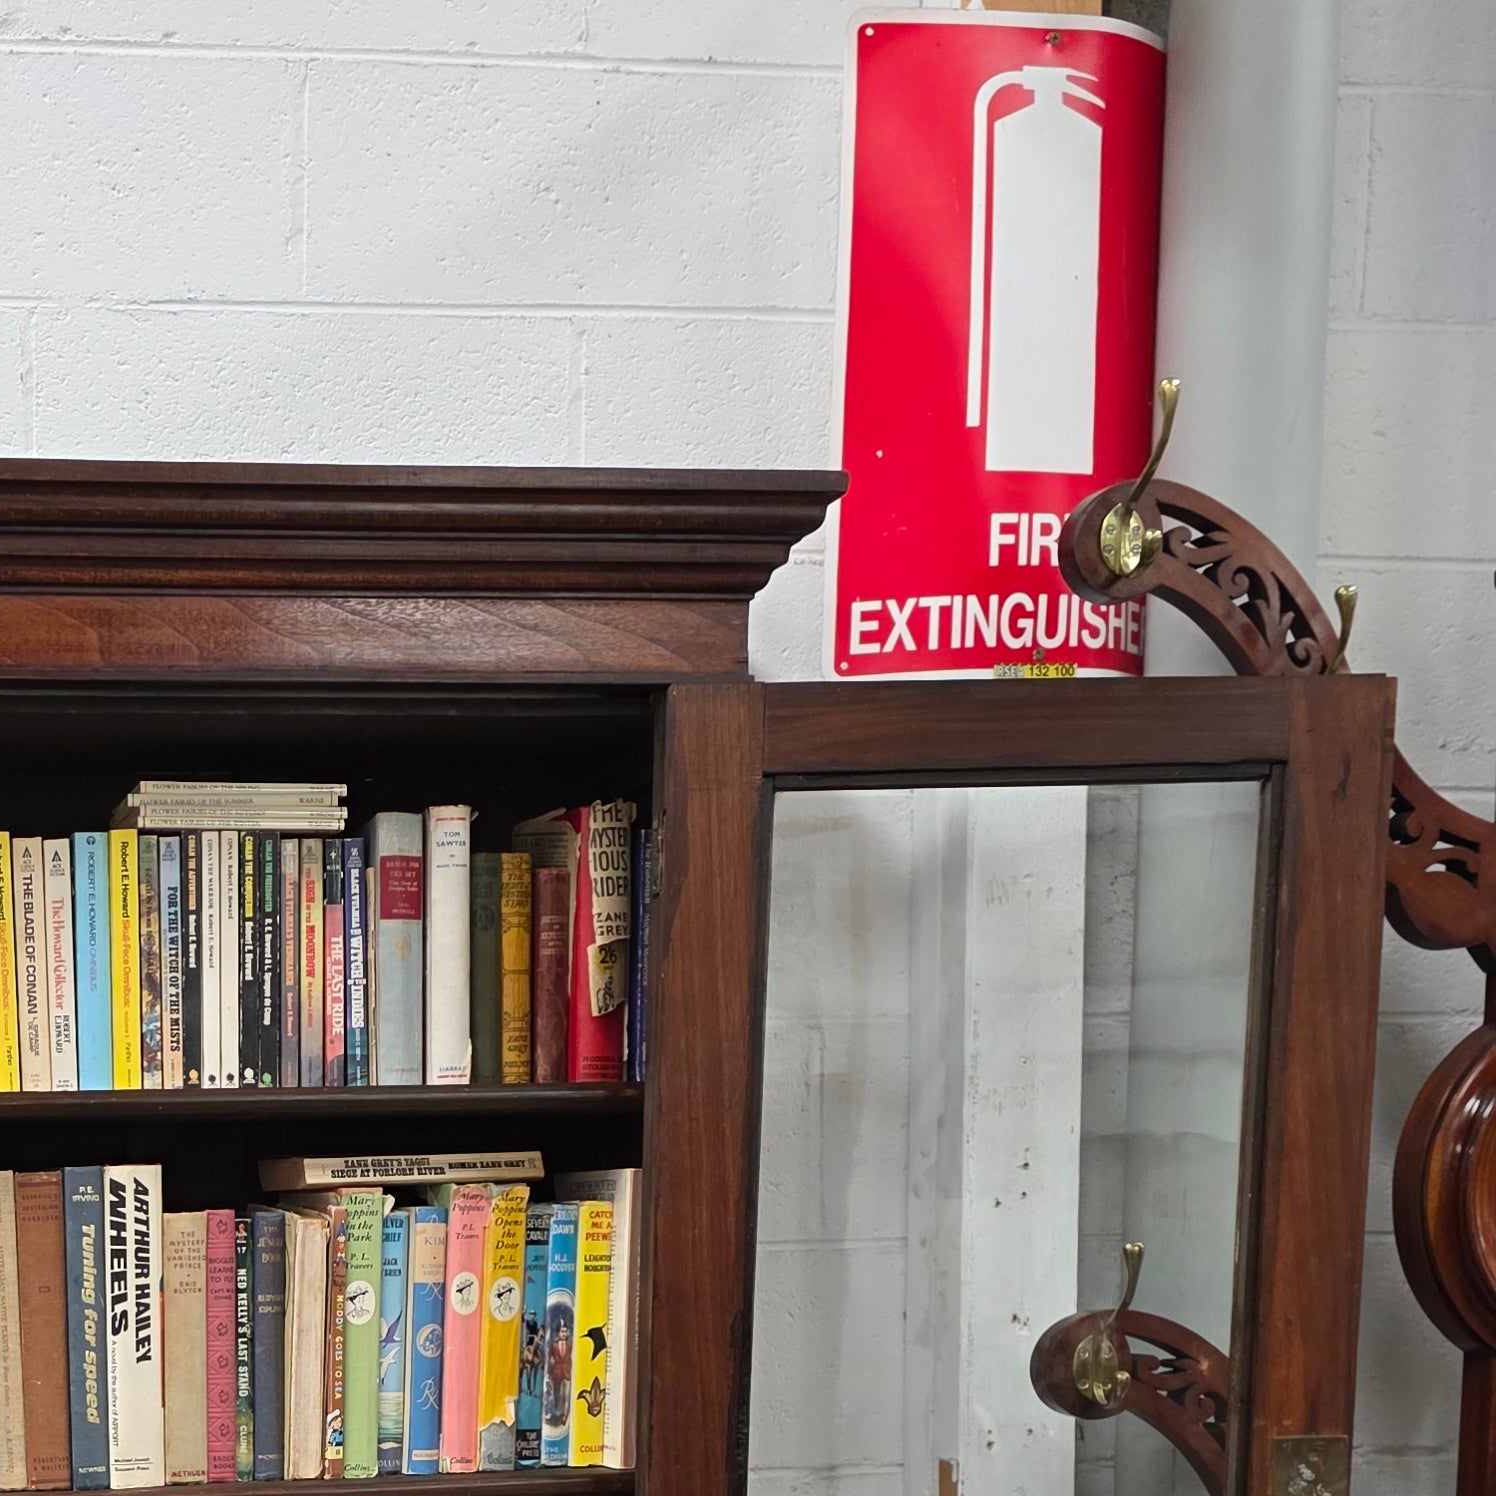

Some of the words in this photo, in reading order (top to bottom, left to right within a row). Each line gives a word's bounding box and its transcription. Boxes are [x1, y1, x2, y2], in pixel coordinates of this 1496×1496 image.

[989, 512, 1072, 567] FIR
[1029, 665, 1050, 676] 132
[1054, 665, 1074, 676] 100
[22, 874, 34, 900] THE
[167, 886, 179, 909] FOR
[23, 902, 35, 943] BLADE
[52, 897, 64, 919] The
[167, 910, 179, 934] THE
[596, 913, 628, 922] ZANE
[25, 945, 36, 962] OF
[52, 920, 65, 964] Howard
[168, 936, 180, 974] WITCH
[26, 964, 38, 1014] CONAN
[54, 966, 67, 1010] Collector
[169, 976, 181, 991] OF
[170, 994, 181, 1015] THE
[170, 1018, 182, 1052] MISTS
[331, 1170, 357, 1178] SIEGE
[360, 1169, 370, 1177] AT
[373, 1168, 415, 1177] FORLORN
[418, 1167, 446, 1175] RIVER
[344, 1160, 368, 1168] ZANE
[371, 1159, 402, 1167] GREY'S
[404, 1158, 430, 1166] YAQUI
[133, 1177, 150, 1283] ARTHUR
[81, 1224, 96, 1305] Tuning
[109, 1178, 128, 1337] WHEELS
[237, 1268, 246, 1291] NED
[83, 1309, 97, 1346] for
[135, 1288, 152, 1364] HAILEY
[237, 1293, 248, 1338] KELLY'S
[237, 1340, 248, 1364] LAST
[83, 1350, 101, 1424] speed
[238, 1366, 248, 1397] STAND
